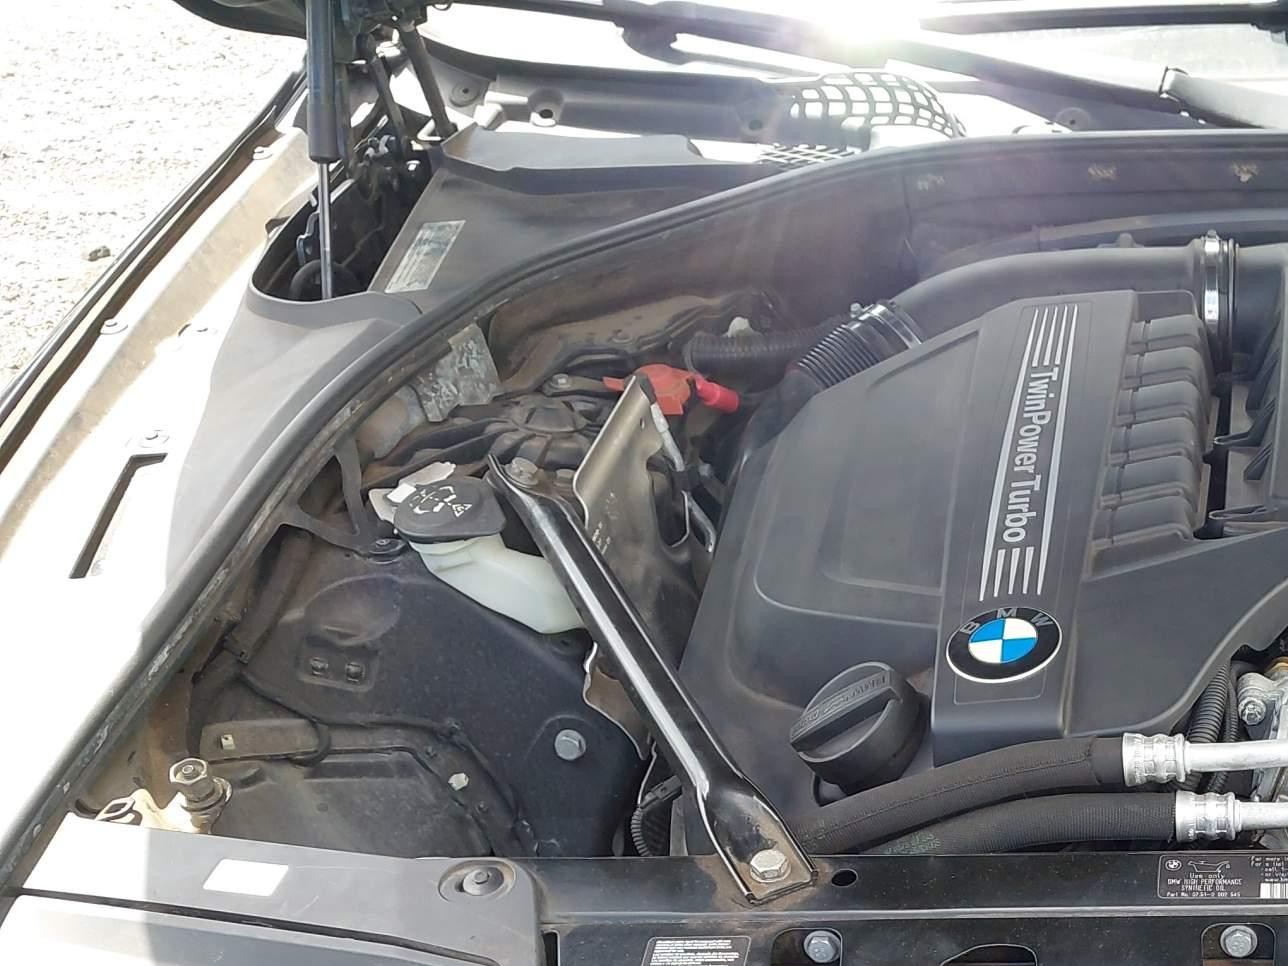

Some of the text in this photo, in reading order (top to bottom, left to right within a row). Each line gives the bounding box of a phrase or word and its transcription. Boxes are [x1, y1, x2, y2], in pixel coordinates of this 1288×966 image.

[1003, 367, 1059, 542] TwinPower Turbo
[960, 608, 1053, 634] BMW
[1208, 871, 1225, 880] only
